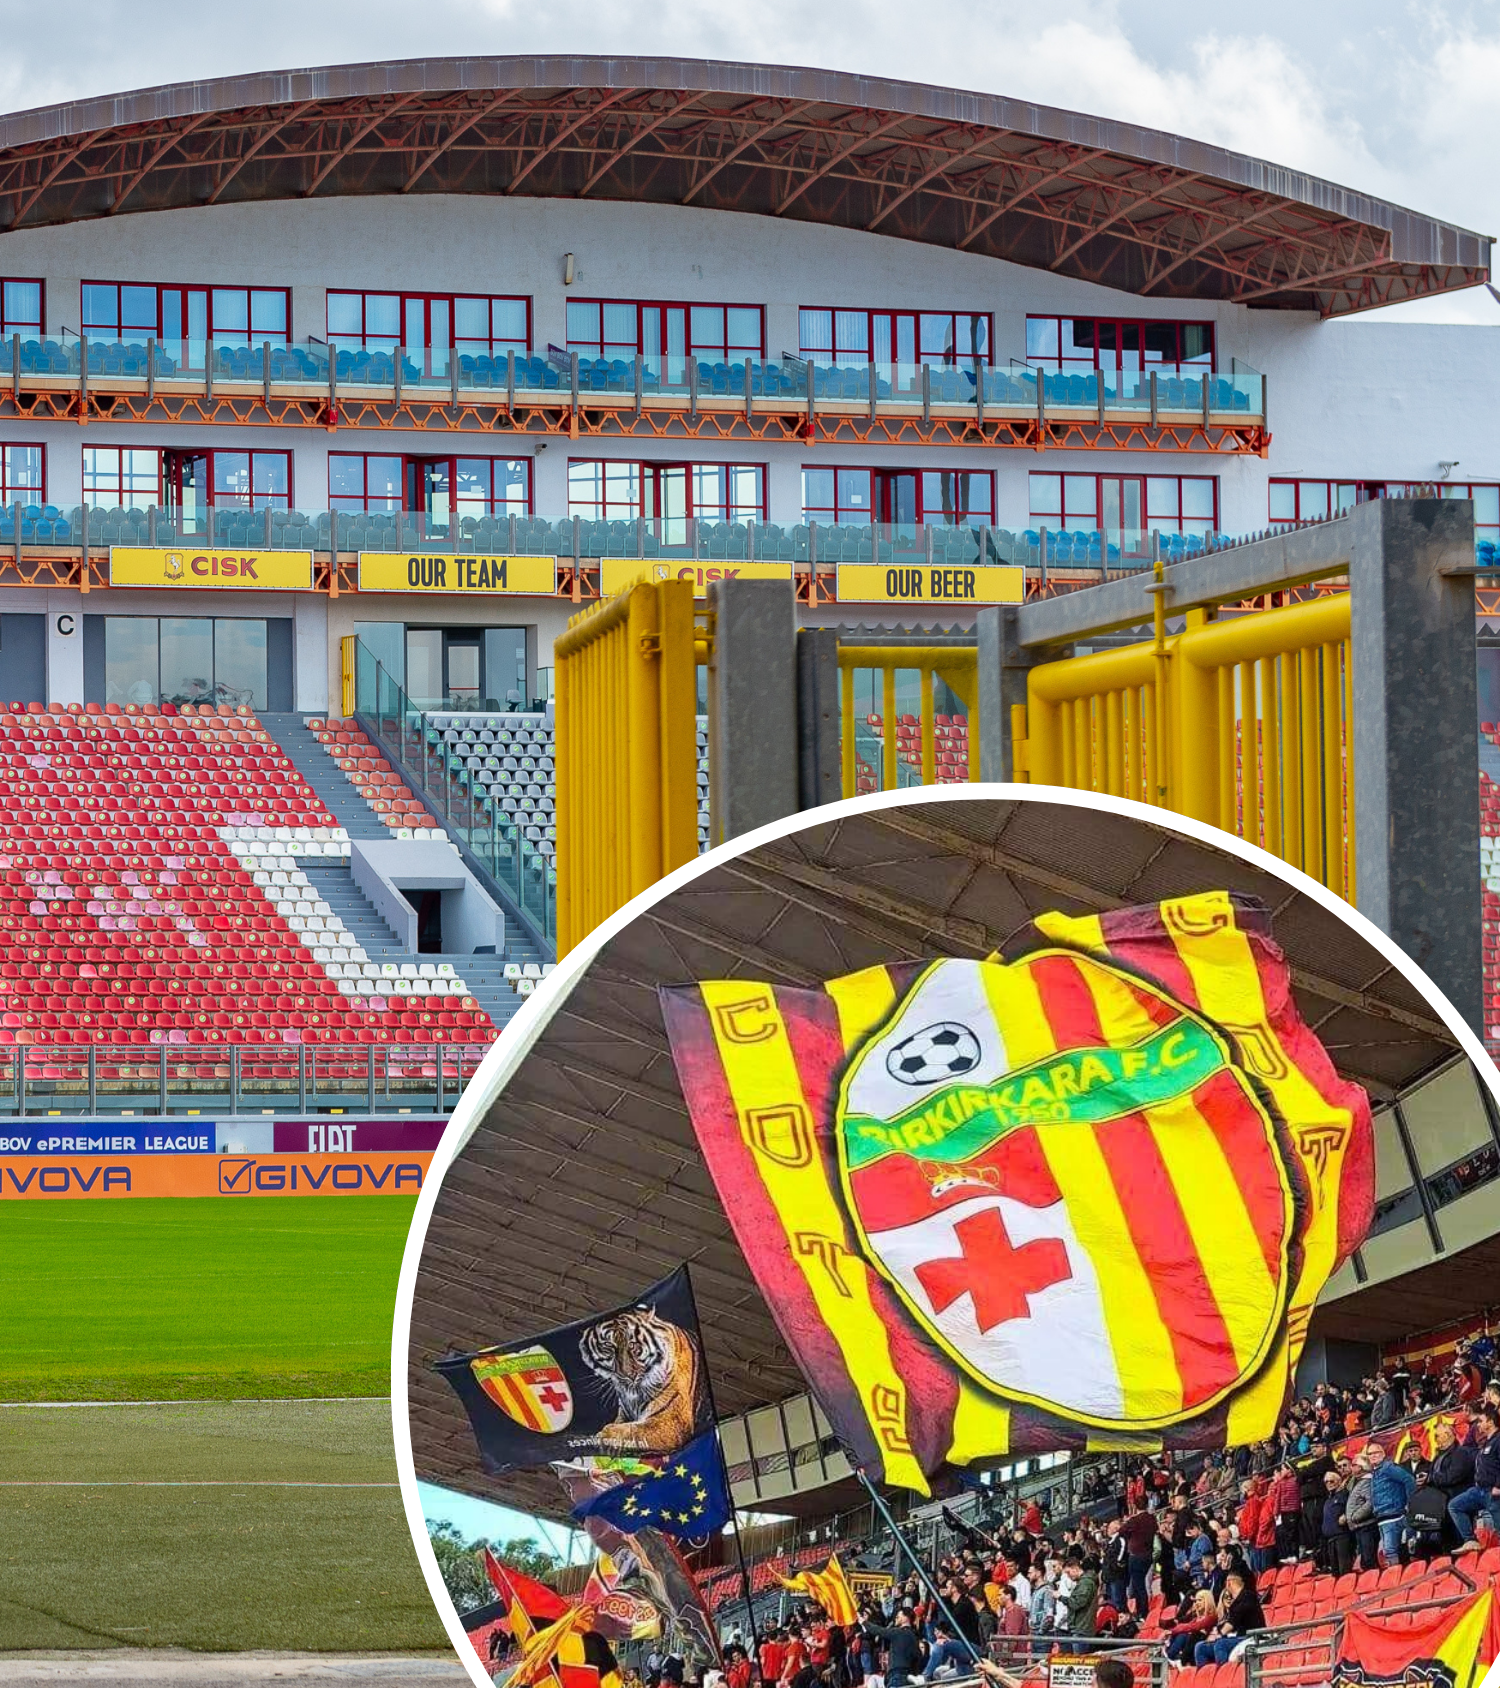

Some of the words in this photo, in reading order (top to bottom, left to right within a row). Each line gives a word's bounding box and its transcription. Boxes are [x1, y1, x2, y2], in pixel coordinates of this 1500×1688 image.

[191, 556, 258, 580] CISK
[408, 557, 446, 588] OUR
[454, 558, 508, 588] TEAM
[886, 569, 922, 597] OUR
[931, 570, 975, 598] BEER
[57, 615, 74, 635] C
[0, 1137, 31, 1151] BOV
[37, 1136, 136, 1151] ePREMIER
[145, 1135, 208, 1150] LEAGUE
[308, 1125, 357, 1152] FIAT
[257, 1163, 423, 1190] GIVOVA
